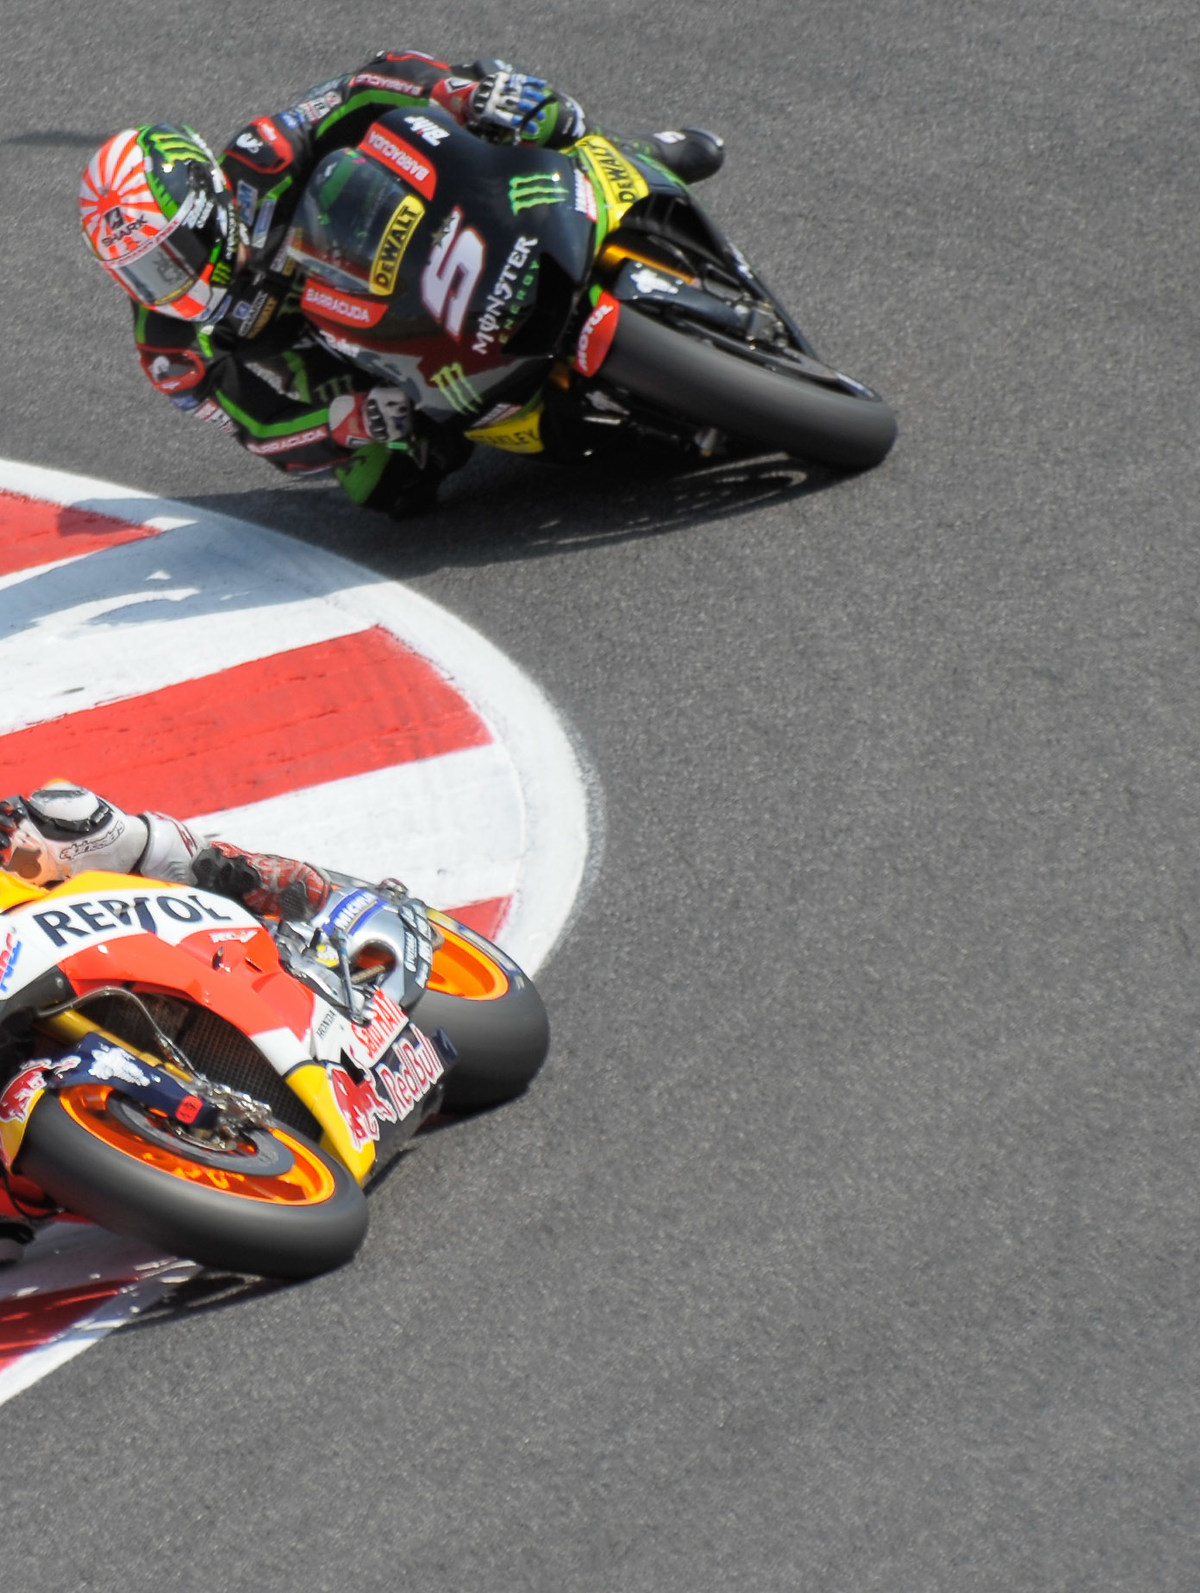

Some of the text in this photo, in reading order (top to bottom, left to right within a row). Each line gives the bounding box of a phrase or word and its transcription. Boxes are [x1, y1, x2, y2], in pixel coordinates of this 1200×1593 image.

[367, 131, 430, 183] BARRACUDA
[101, 214, 147, 247] SHARK
[375, 205, 419, 288] DEWALT
[304, 287, 372, 323] BARRACUDA
[421, 204, 488, 343] 5
[471, 235, 539, 355] MONSTER
[499, 259, 541, 345] ENERGY
[577, 302, 615, 373] MOTUL
[32, 894, 232, 948] REPSOL
